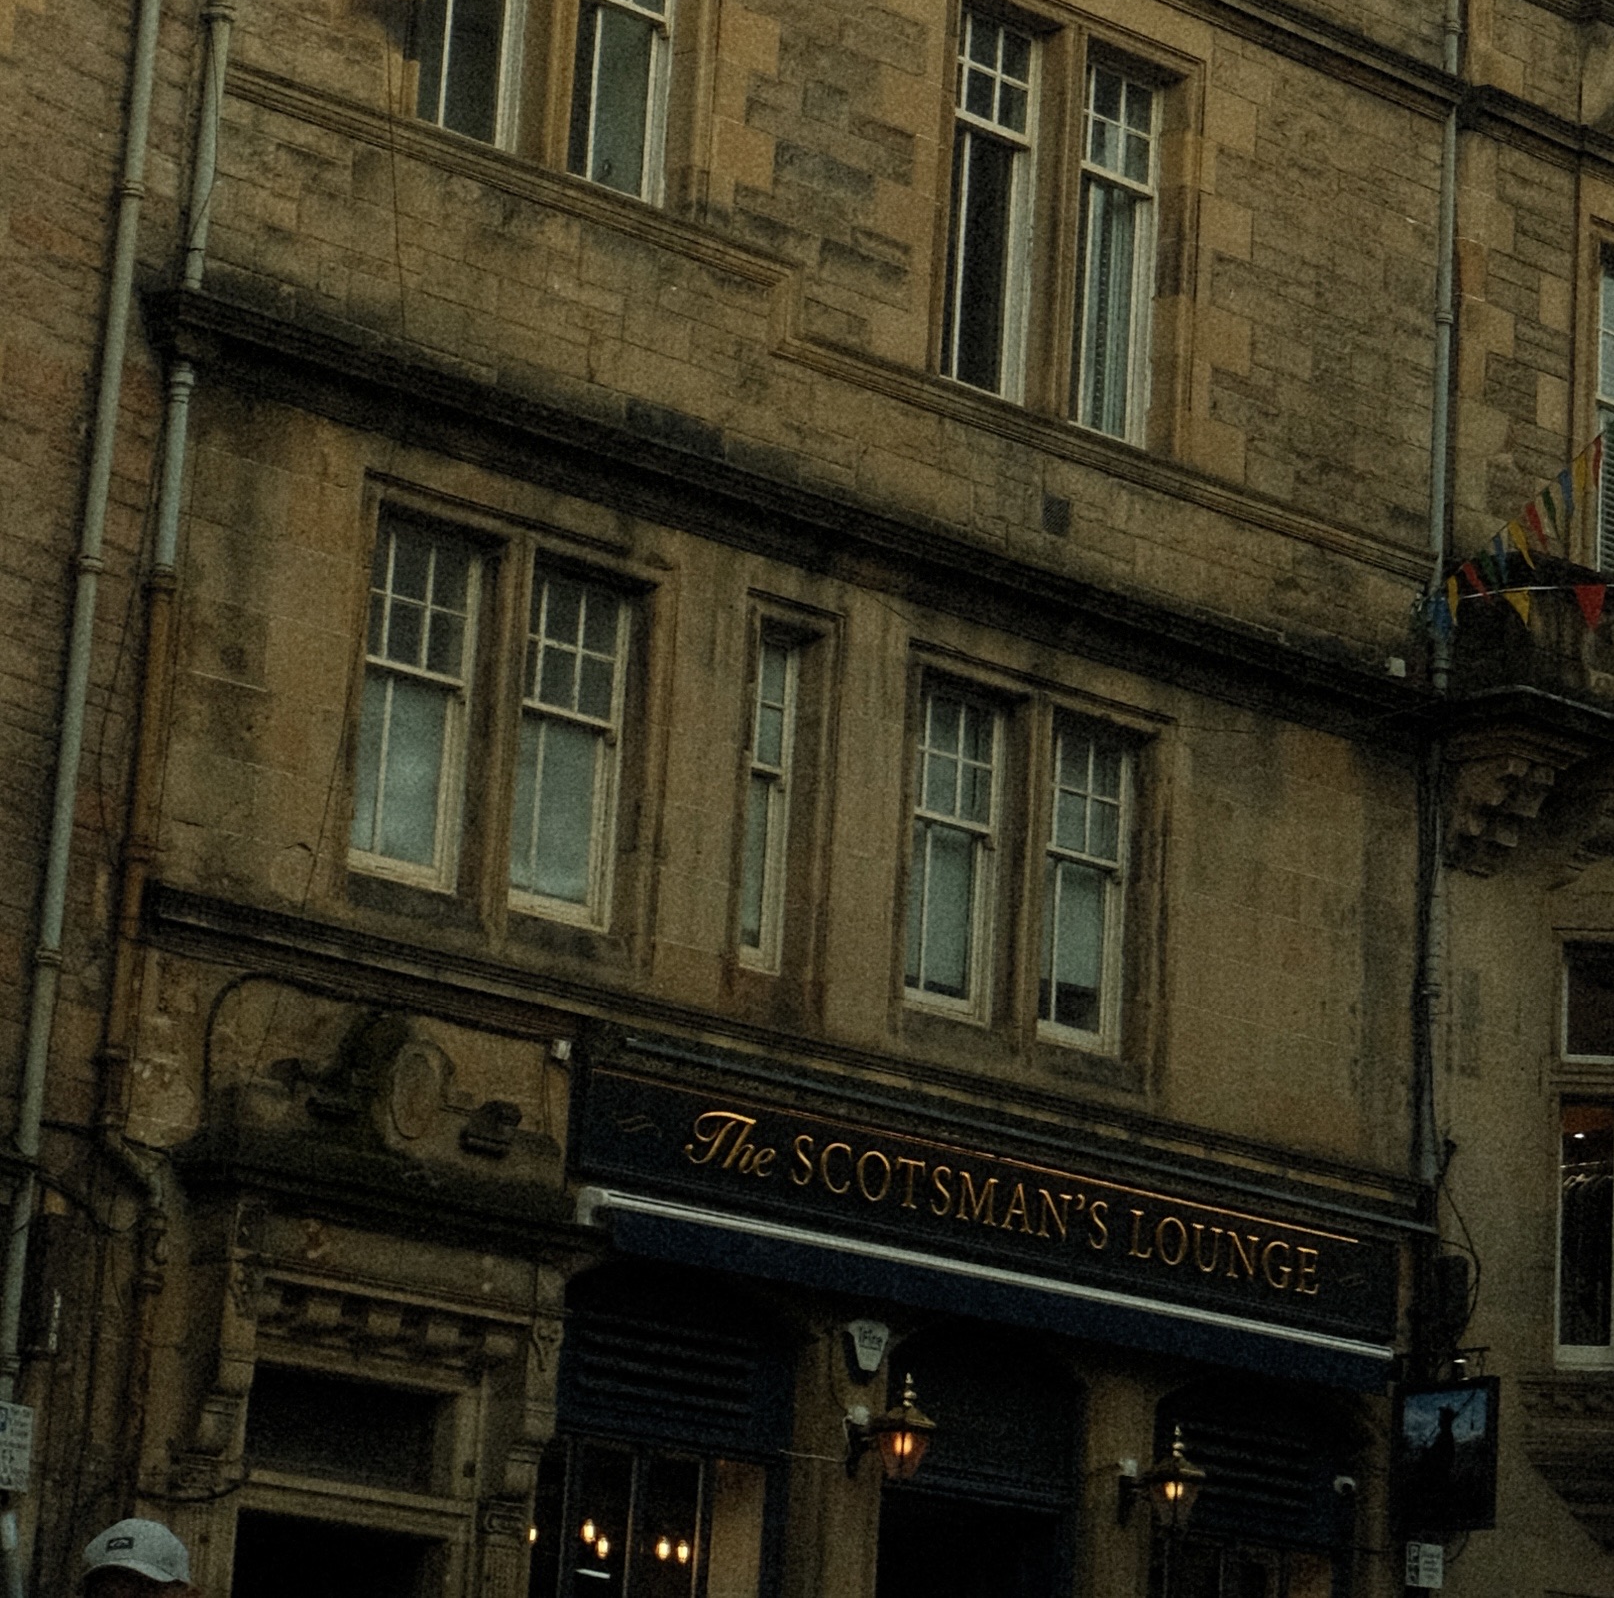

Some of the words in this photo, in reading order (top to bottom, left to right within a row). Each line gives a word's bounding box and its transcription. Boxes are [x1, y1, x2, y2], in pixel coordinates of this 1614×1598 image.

[684, 1110, 777, 1178] The
[791, 1134, 1108, 1250] SCOTSMAN'S
[1128, 1209, 1320, 1295] LOUNGE
